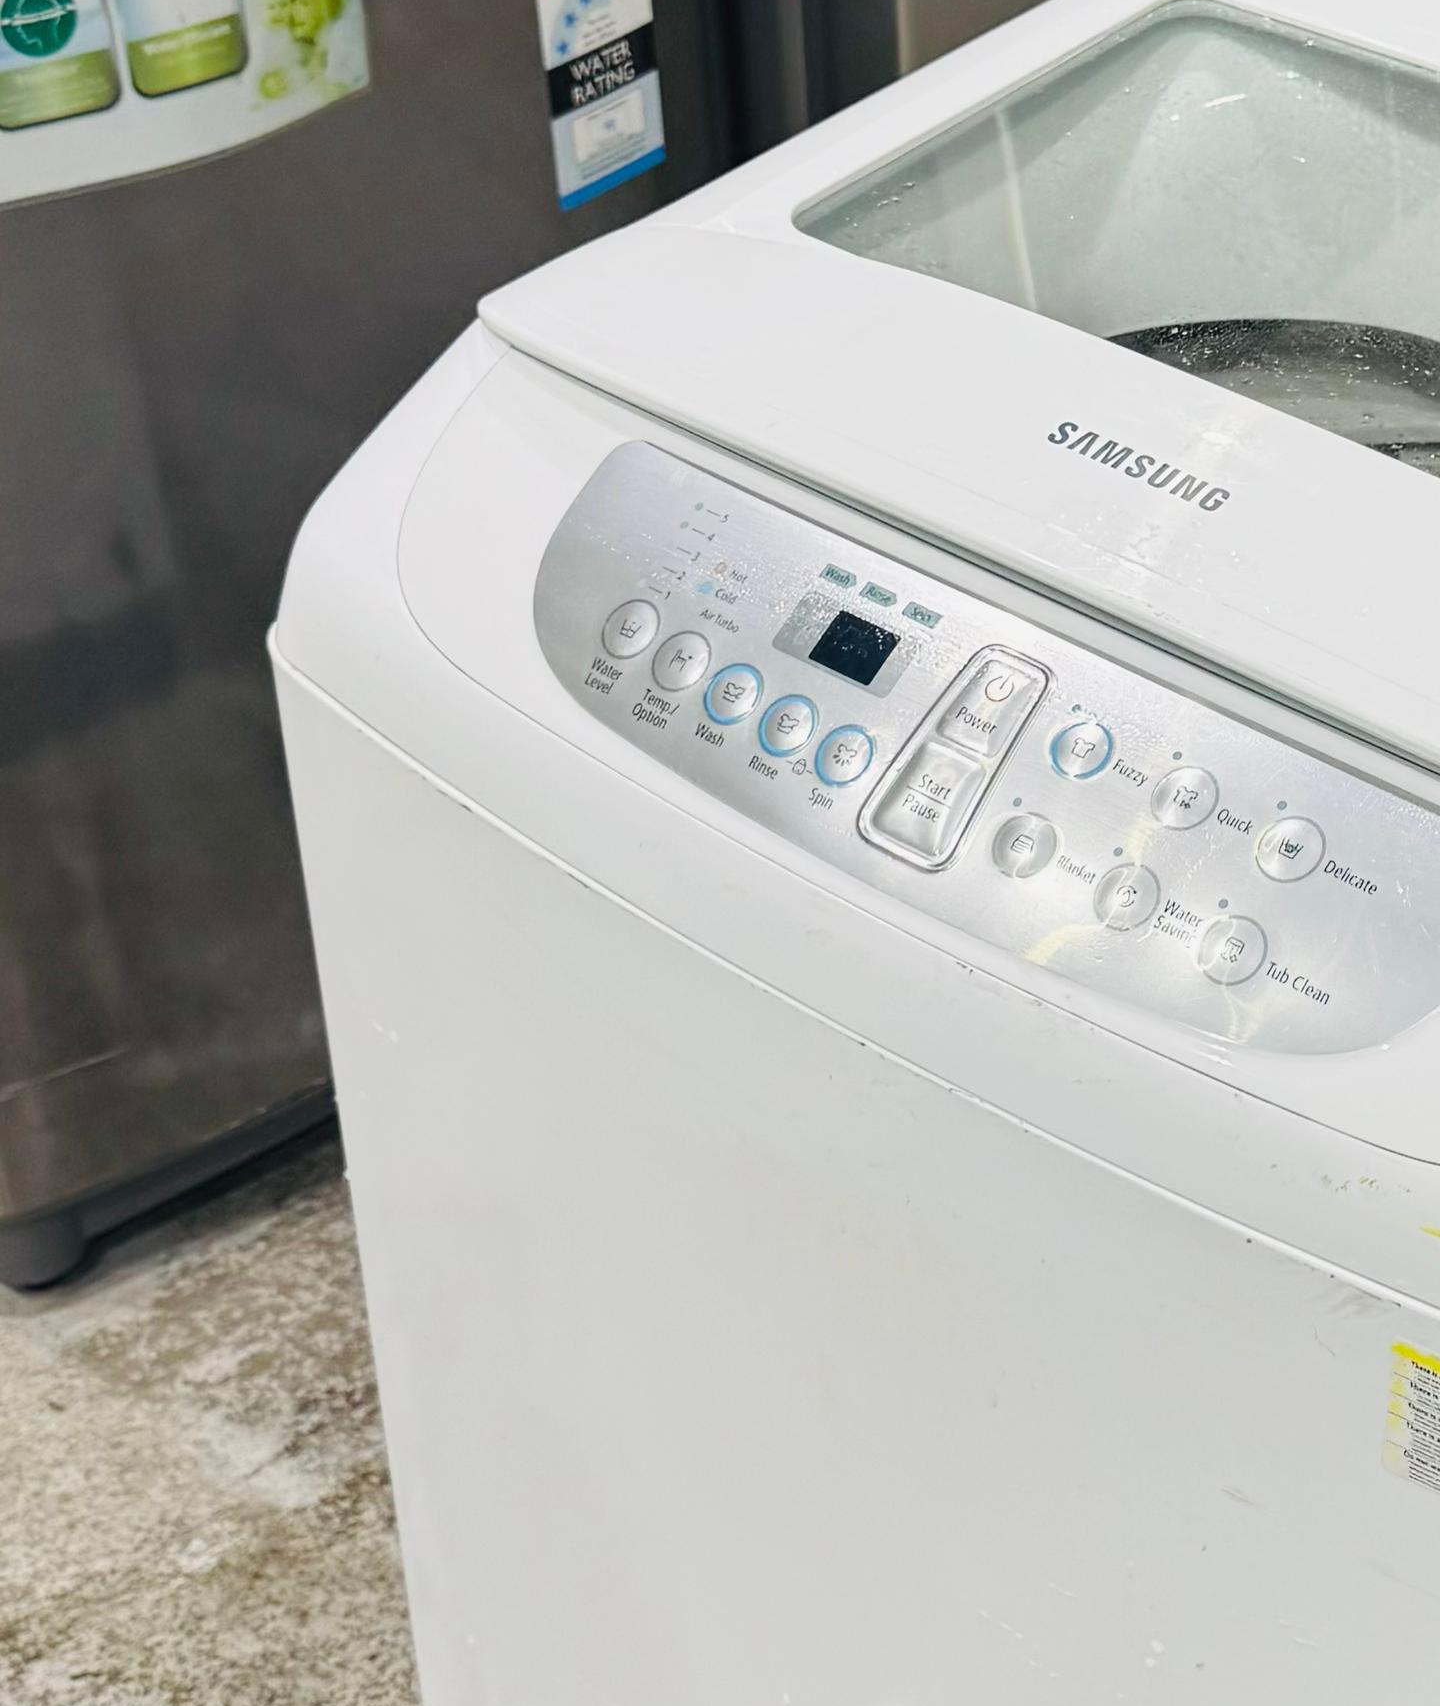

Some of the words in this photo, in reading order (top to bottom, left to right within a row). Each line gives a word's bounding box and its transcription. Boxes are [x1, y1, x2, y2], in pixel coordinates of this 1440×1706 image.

[569, 39, 633, 81] WATER
[571, 61, 636, 107] RATING
[1047, 421, 1231, 512] SAMSUNG
[824, 566, 851, 587] Wash
[714, 588, 739, 605] Cold
[591, 656, 623, 682] Water
[584, 672, 614, 696] Level
[631, 703, 668, 731] Option
[955, 705, 998, 735] Power
[694, 723, 725, 748] Wash
[748, 755, 779, 781] Rinse
[1112, 758, 1149, 788] Fuzzy
[808, 787, 835, 811] Spin
[917, 773, 952, 801] Start
[901, 793, 940, 824] Pause
[1216, 808, 1254, 836] Quick
[1056, 854, 1096, 885] Blanket
[1323, 859, 1378, 895] Delicate
[1163, 899, 1203, 929] Water
[1266, 961, 1290, 985] Tub
[1291, 974, 1331, 1006] Clean
